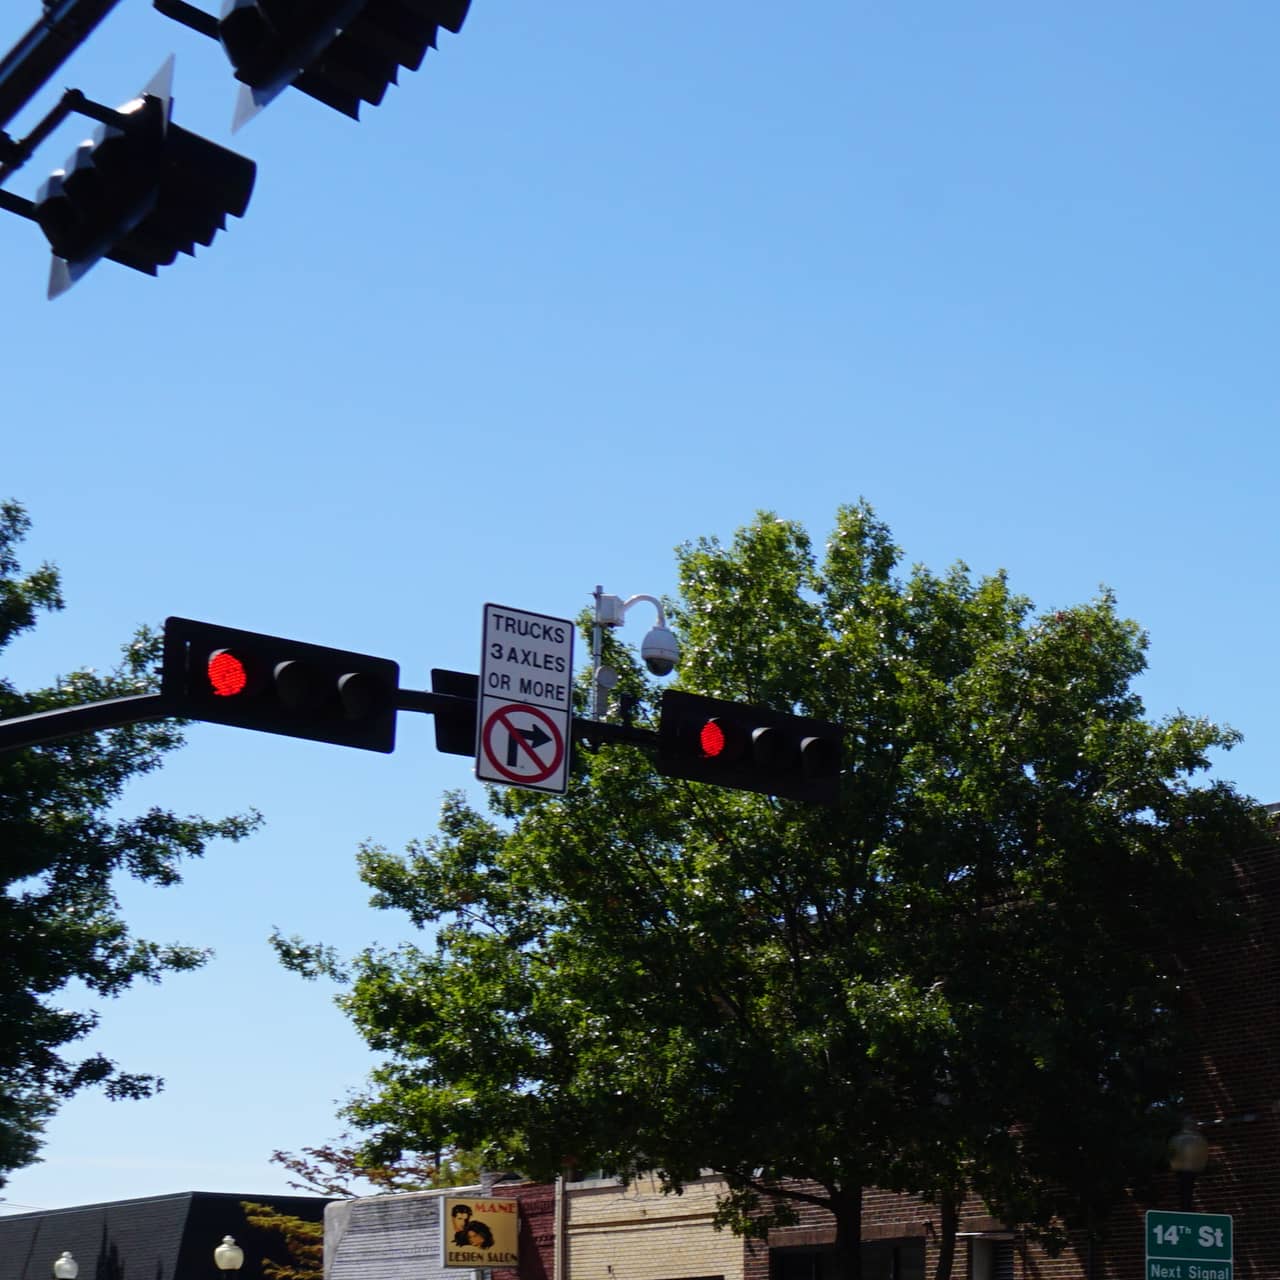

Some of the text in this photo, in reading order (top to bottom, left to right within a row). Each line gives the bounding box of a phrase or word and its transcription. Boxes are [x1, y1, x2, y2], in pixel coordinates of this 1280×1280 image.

[492, 613, 566, 644] TRUCKS
[490, 643, 566, 673] 3 AXLES
[488, 672, 566, 702] OR MORE
[475, 1202, 517, 1214] MANE
[1198, 1225, 1224, 1248] St
[448, 1251, 518, 1263] DESIGN SALON
[1150, 1263, 1182, 1279] Next
